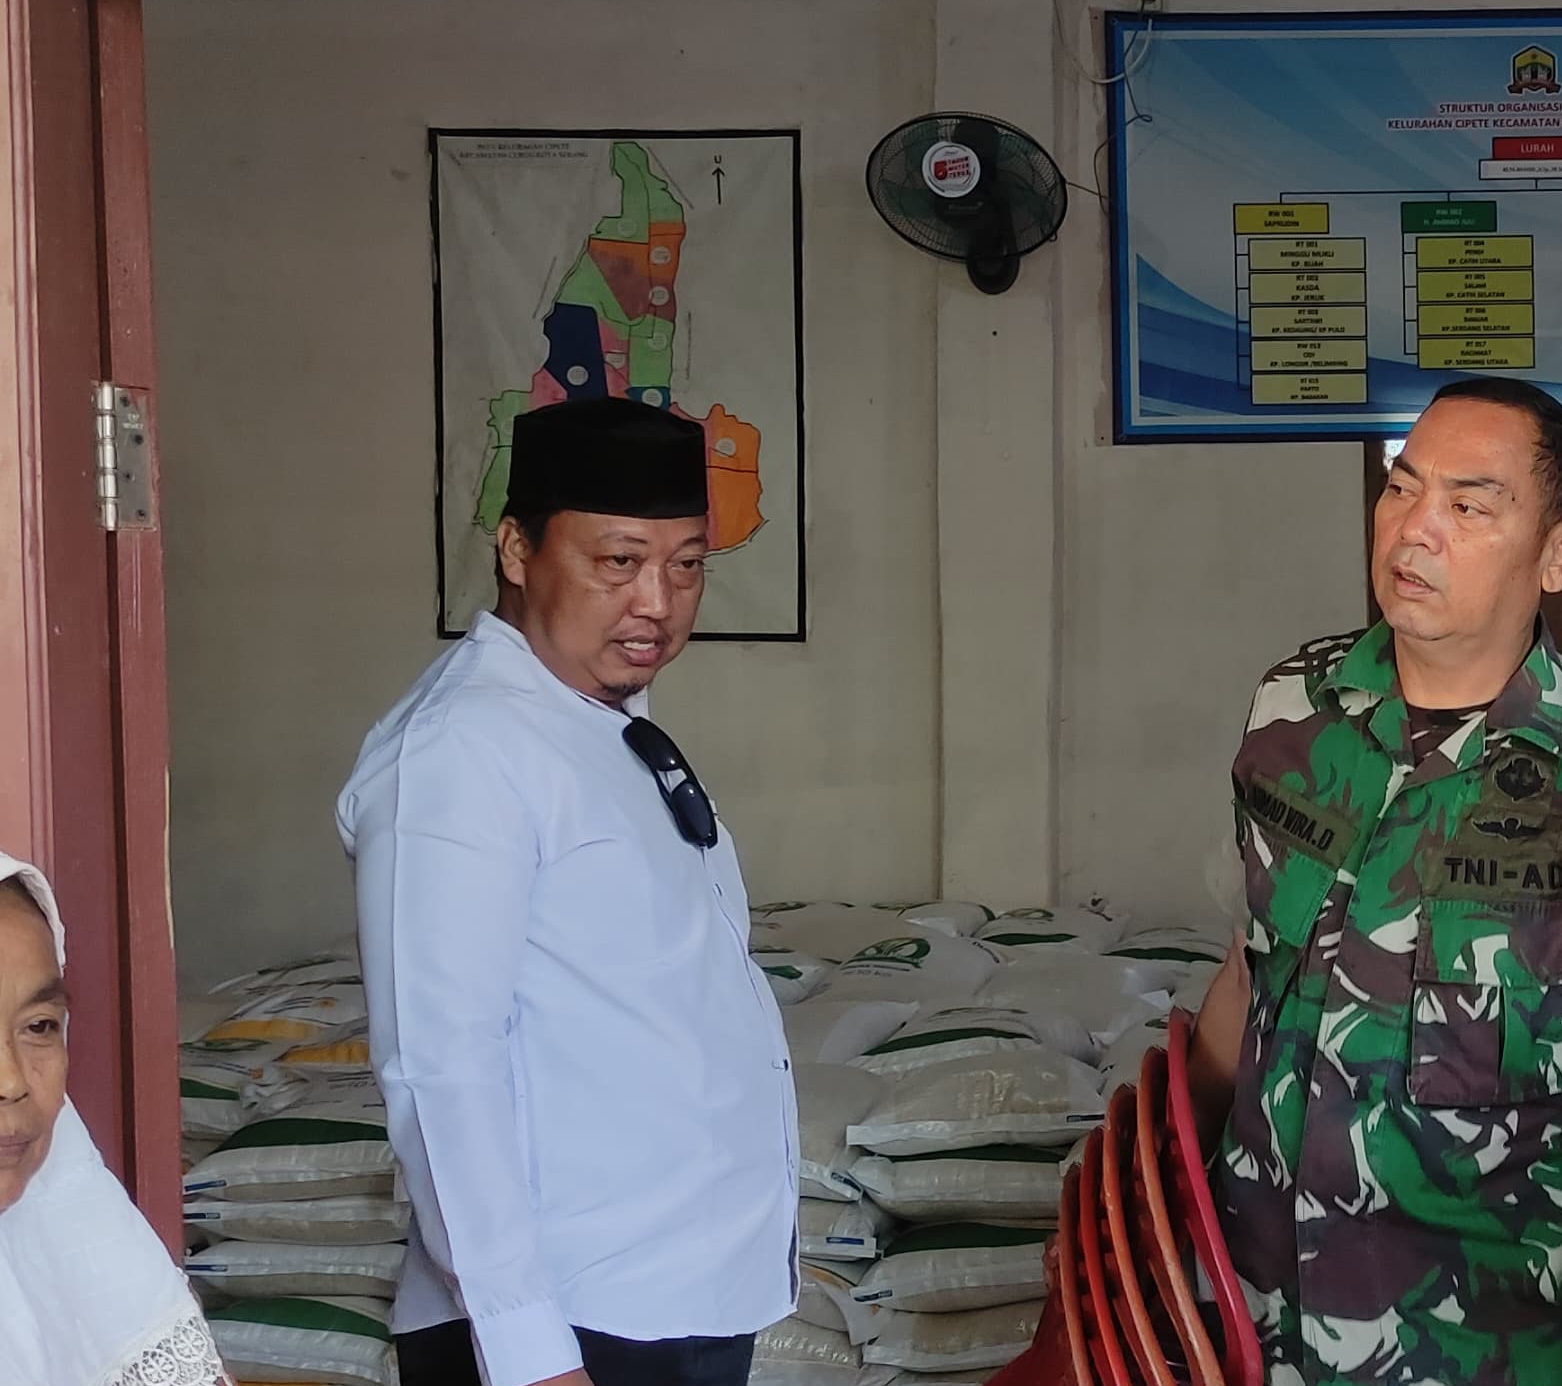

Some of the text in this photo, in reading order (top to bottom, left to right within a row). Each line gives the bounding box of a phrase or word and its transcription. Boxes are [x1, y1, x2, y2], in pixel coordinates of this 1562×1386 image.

[1439, 102, 1494, 114] STRUKTUR
[1497, 102, 1562, 113] ORGANISASI
[1387, 118, 1453, 129] KELURAHAN
[1455, 118, 1489, 129] CIPETE
[1492, 117, 1560, 128] KECAMATAN
[1520, 142, 1555, 154] LURAH
[714, 155, 722, 164] U
